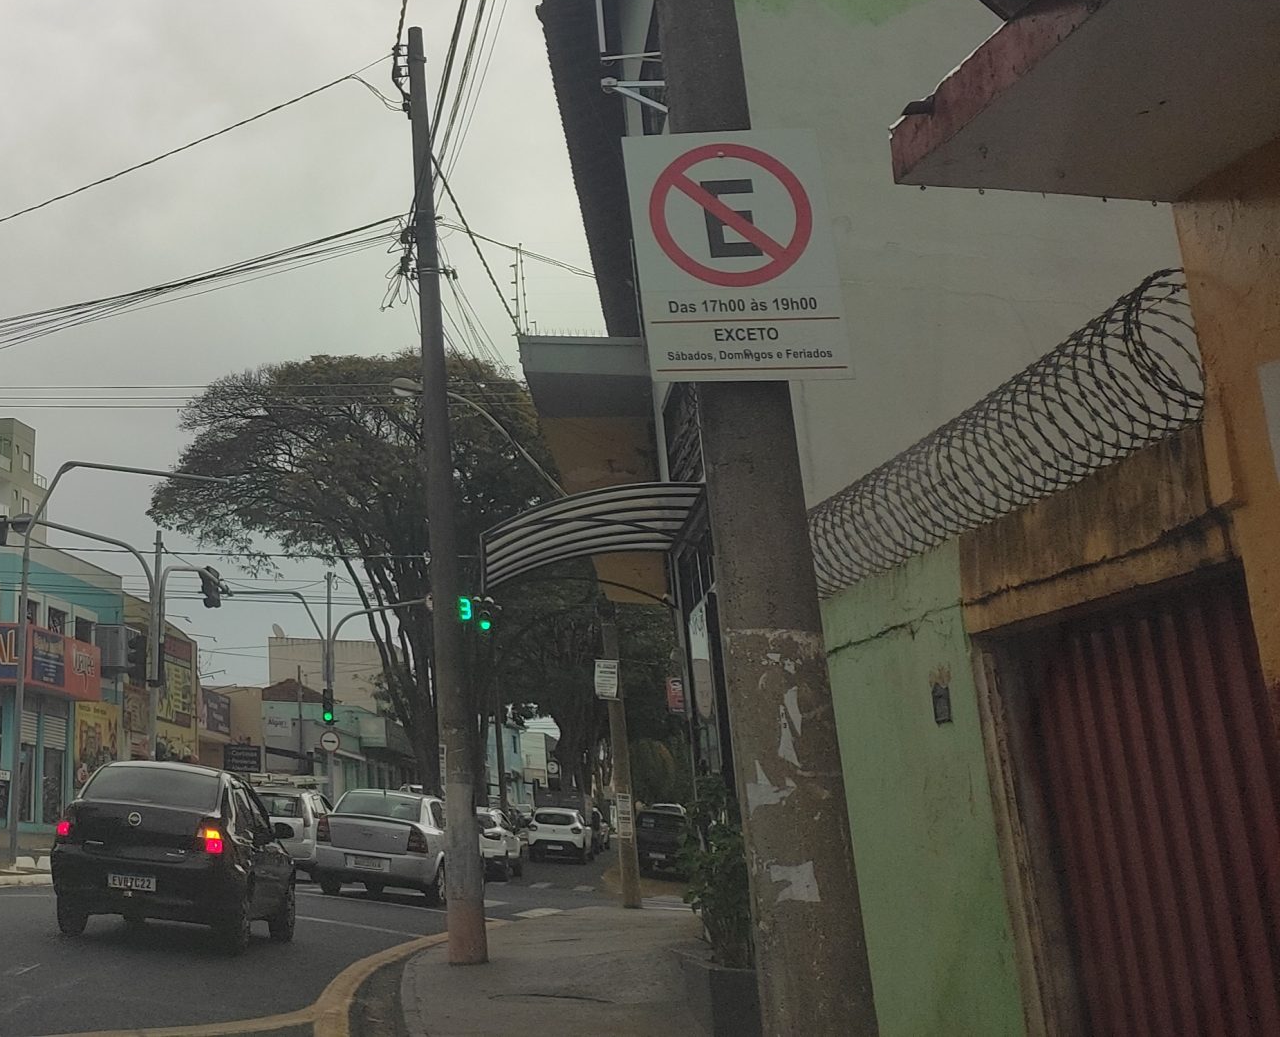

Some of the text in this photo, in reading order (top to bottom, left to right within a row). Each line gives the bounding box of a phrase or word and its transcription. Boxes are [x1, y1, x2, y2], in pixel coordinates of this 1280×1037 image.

[668, 296, 818, 314] Das 17h00 às 19h00
[714, 327, 779, 342] EXCETO
[667, 348, 833, 362] Sábados, Domingos e Feriados
[458, 597, 472, 621] 3
